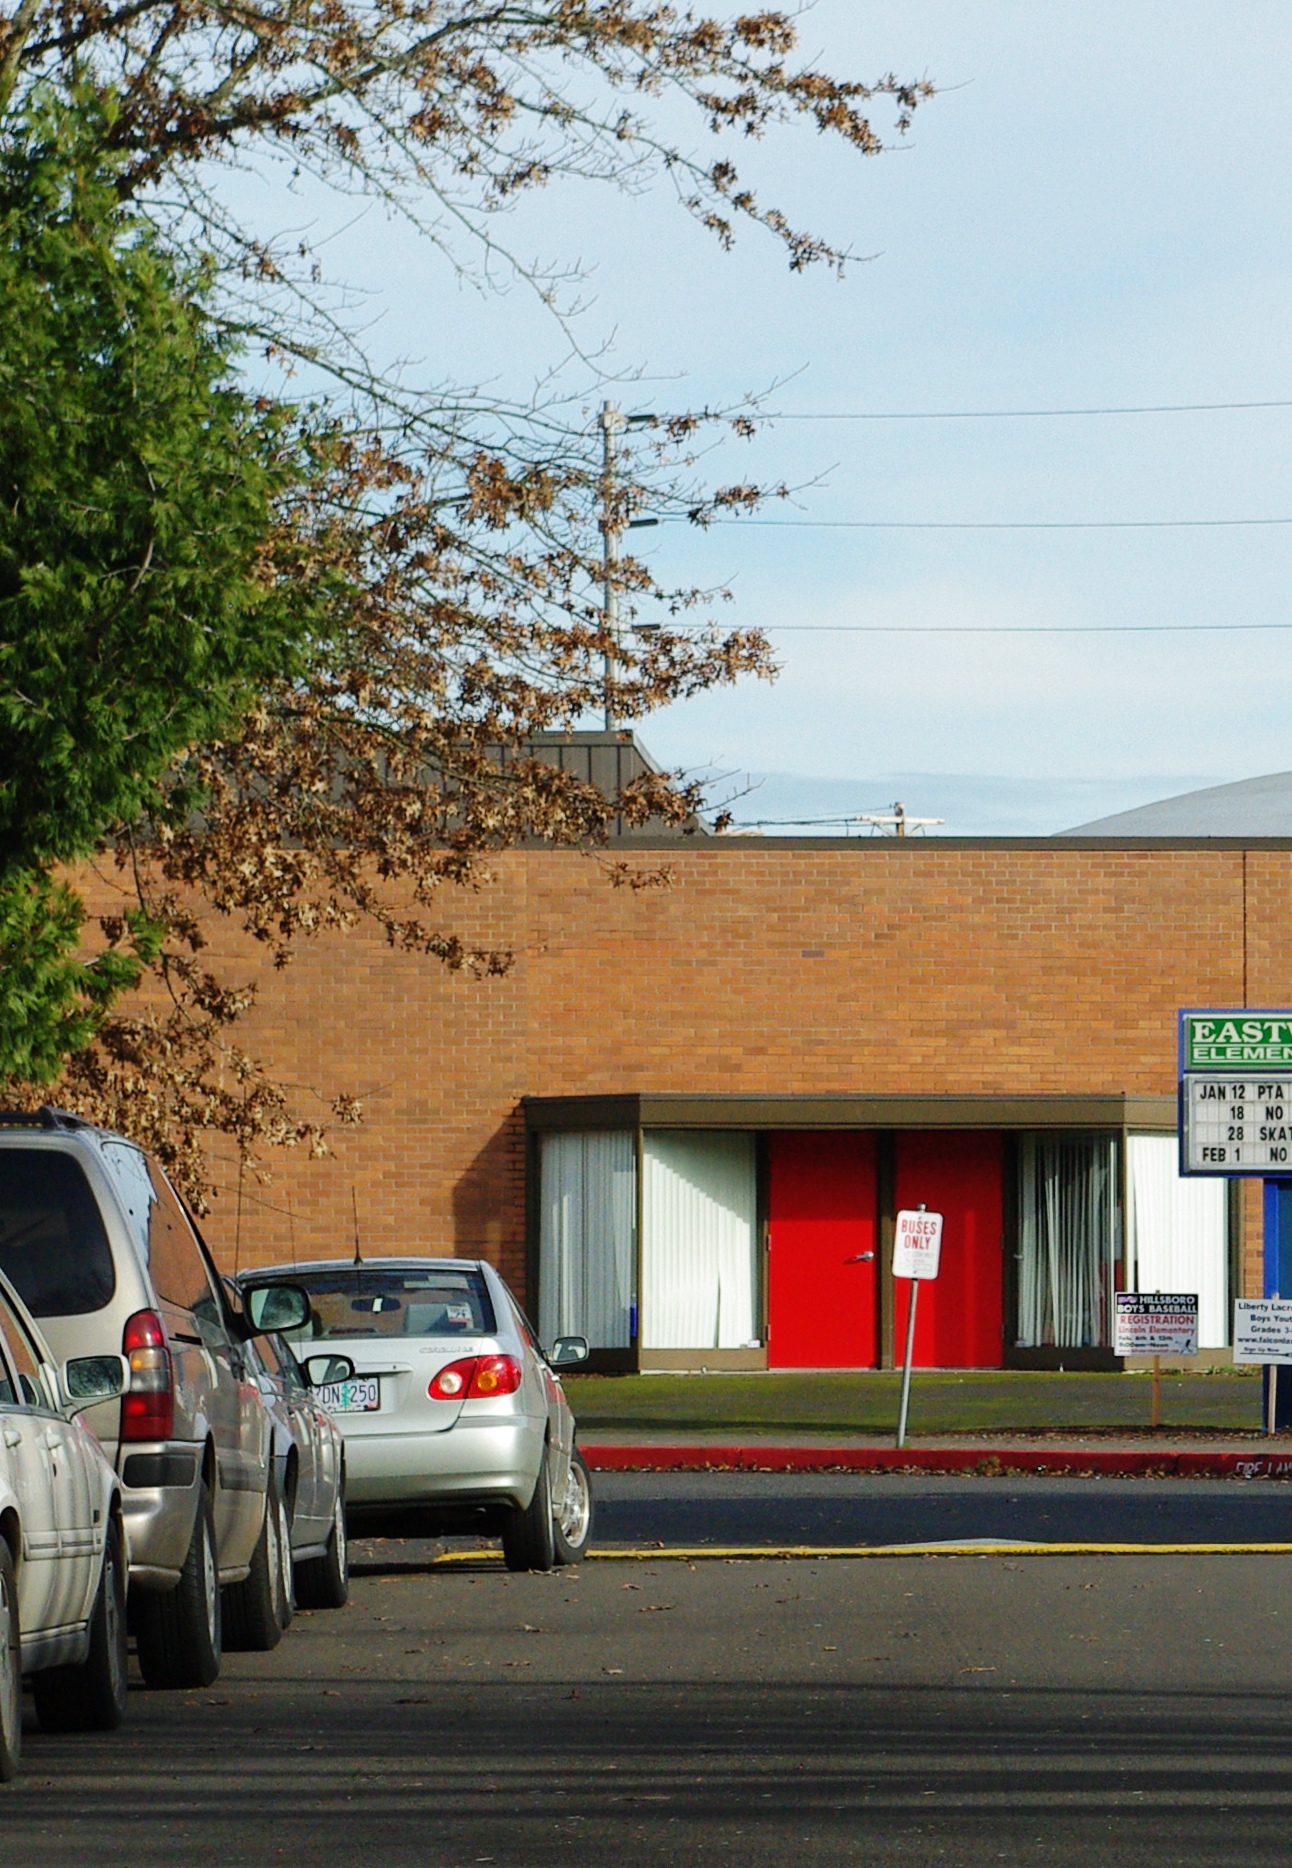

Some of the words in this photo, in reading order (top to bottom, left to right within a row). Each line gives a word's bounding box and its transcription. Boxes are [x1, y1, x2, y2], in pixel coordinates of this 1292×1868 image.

[1200, 1086, 1226, 1100] JAN
[1231, 1084, 1245, 1099] 12
[1257, 1085, 1284, 1099] PTA
[1230, 1106, 1244, 1120] 18
[1266, 1106, 1283, 1120] NO
[1228, 1127, 1244, 1141] 28
[1202, 1147, 1226, 1162] FEB
[1234, 1147, 1241, 1162] 1
[1270, 1148, 1287, 1162] NO
[901, 1219, 937, 1235] BUSES
[904, 1235, 931, 1250] ONLY
[1139, 1295, 1195, 1304] HILLSBORO
[1118, 1304, 1145, 1313] BOYS
[1149, 1304, 1197, 1313] BASEBALL
[1238, 1302, 1268, 1312] Liberty
[1120, 1315, 1194, 1325] REGISTRATION
[1250, 1314, 1271, 1323] Boys
[1149, 1326, 1195, 1336] Elementary
[1250, 1325, 1281, 1333] Grades
[350, 1384, 376, 1403] 250
